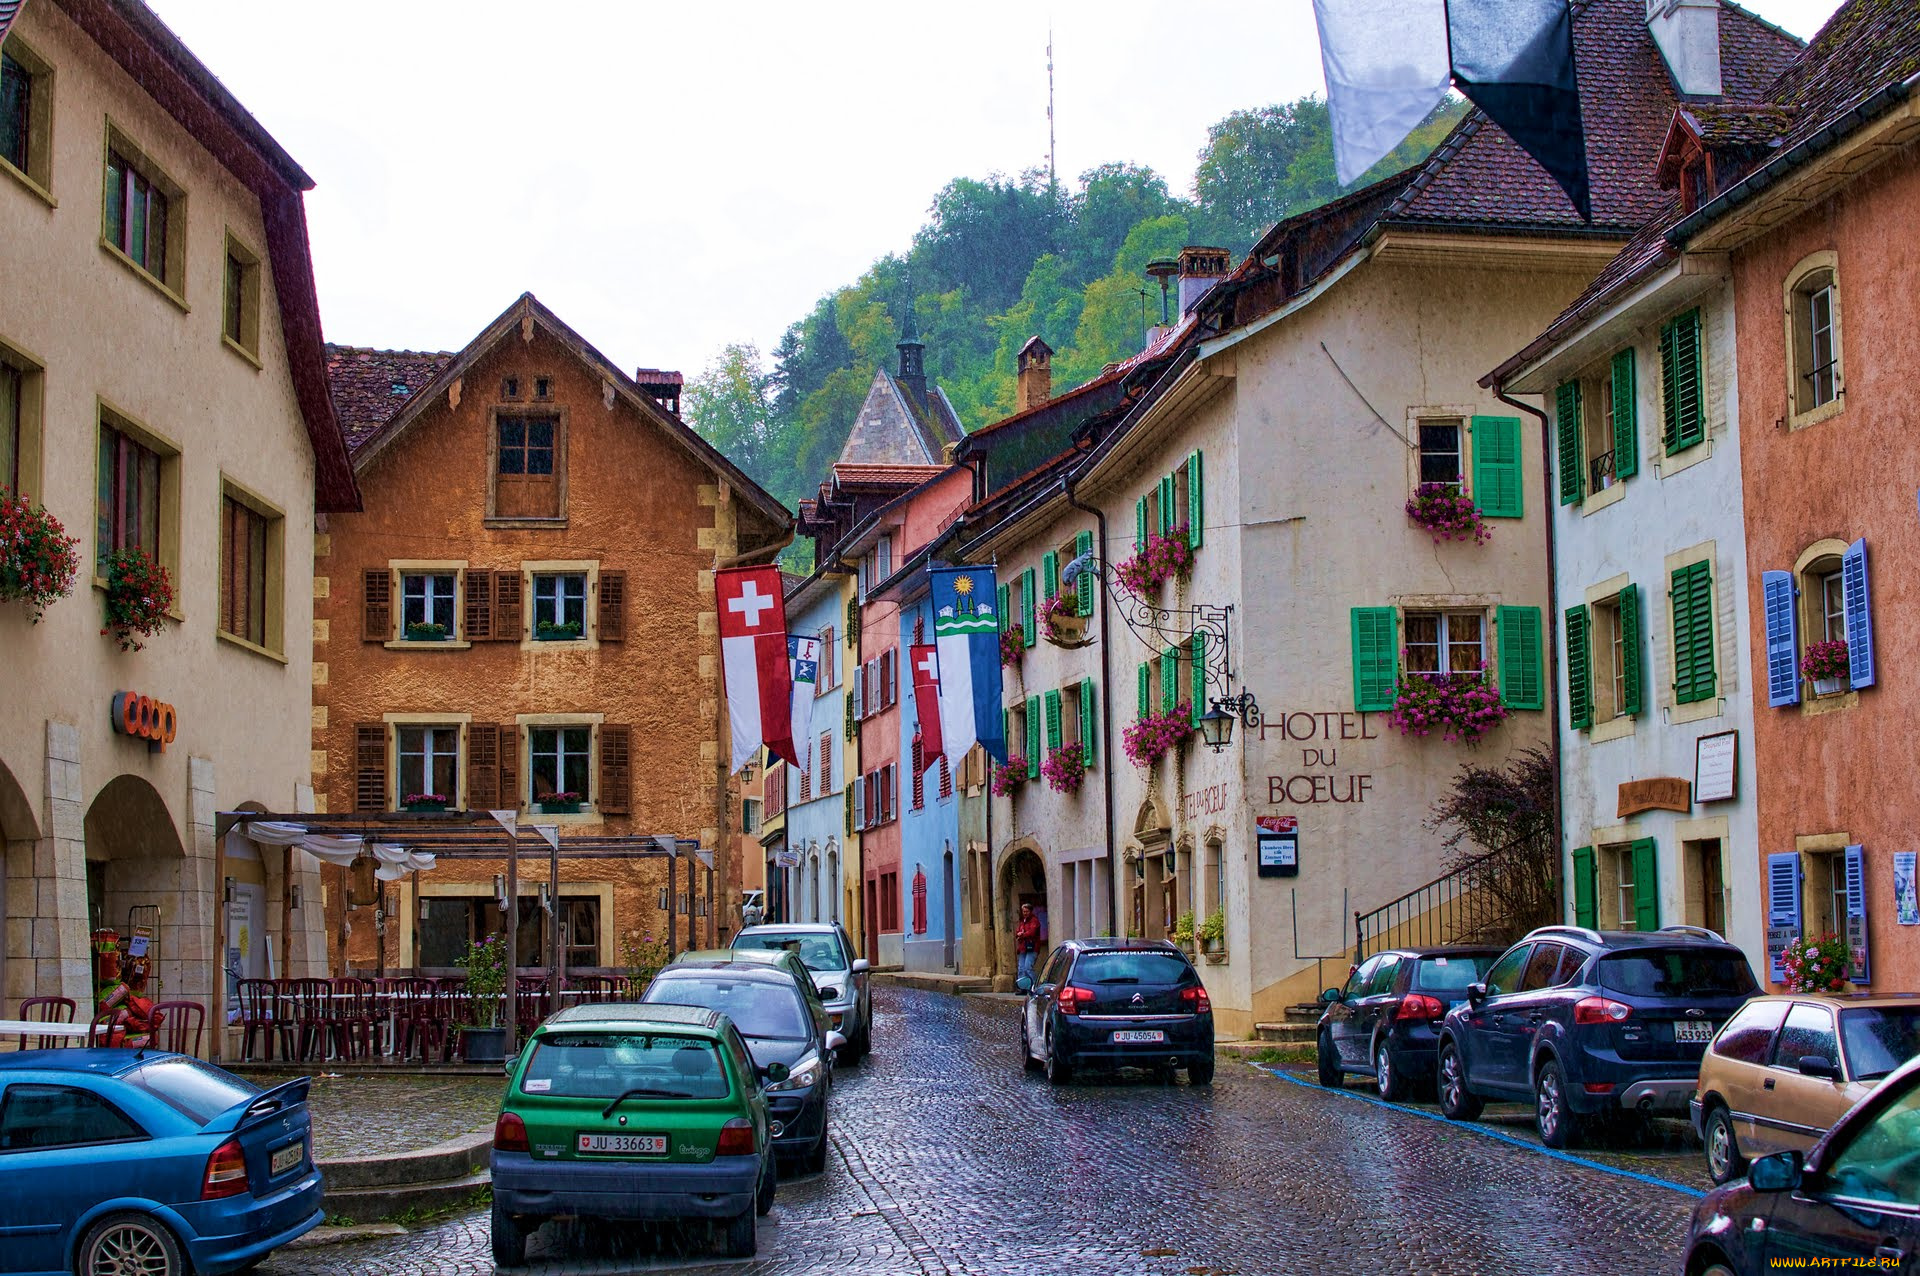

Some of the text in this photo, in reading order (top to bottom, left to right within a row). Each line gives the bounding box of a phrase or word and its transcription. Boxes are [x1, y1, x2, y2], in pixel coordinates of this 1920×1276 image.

[1259, 712, 1378, 740] HOTEL
[1302, 749, 1336, 766] DU
[1267, 775, 1372, 804] BŒUF
